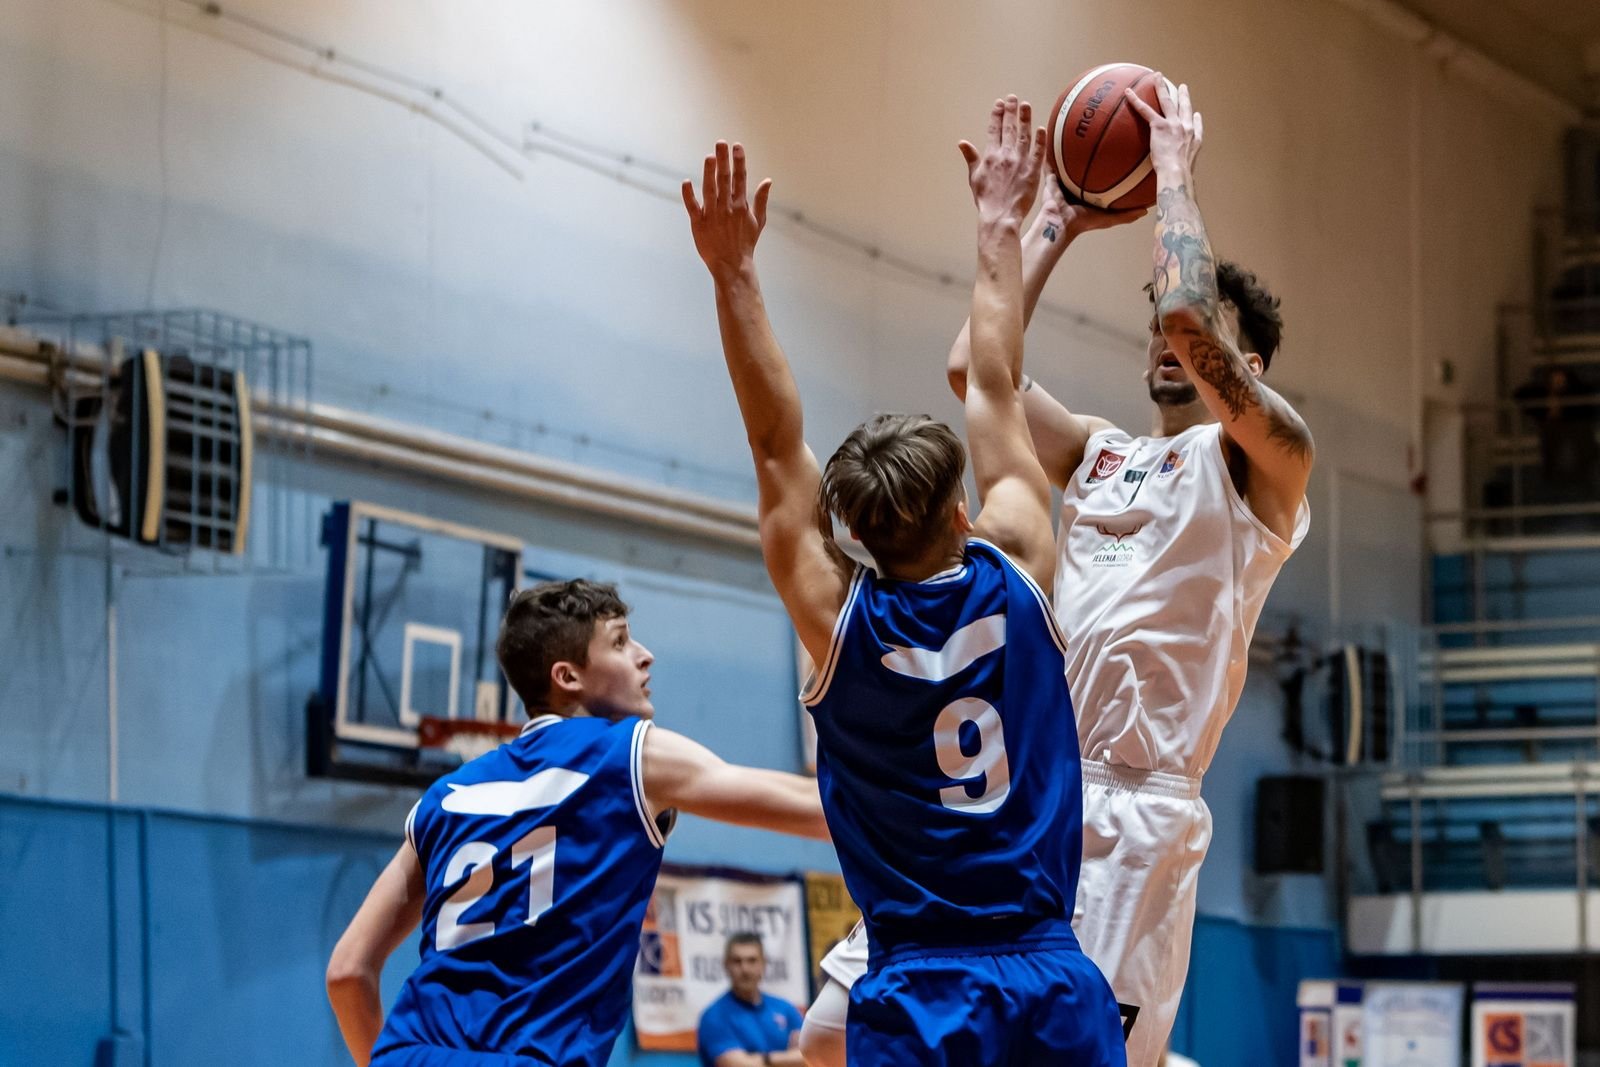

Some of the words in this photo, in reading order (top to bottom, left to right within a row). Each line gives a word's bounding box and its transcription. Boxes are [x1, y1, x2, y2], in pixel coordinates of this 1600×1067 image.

[1075, 80, 1116, 138] molten
[1092, 554, 1116, 562] JELENIA
[933, 696, 1011, 814] 9
[435, 824, 557, 952] 21
[686, 900, 714, 934] KS
